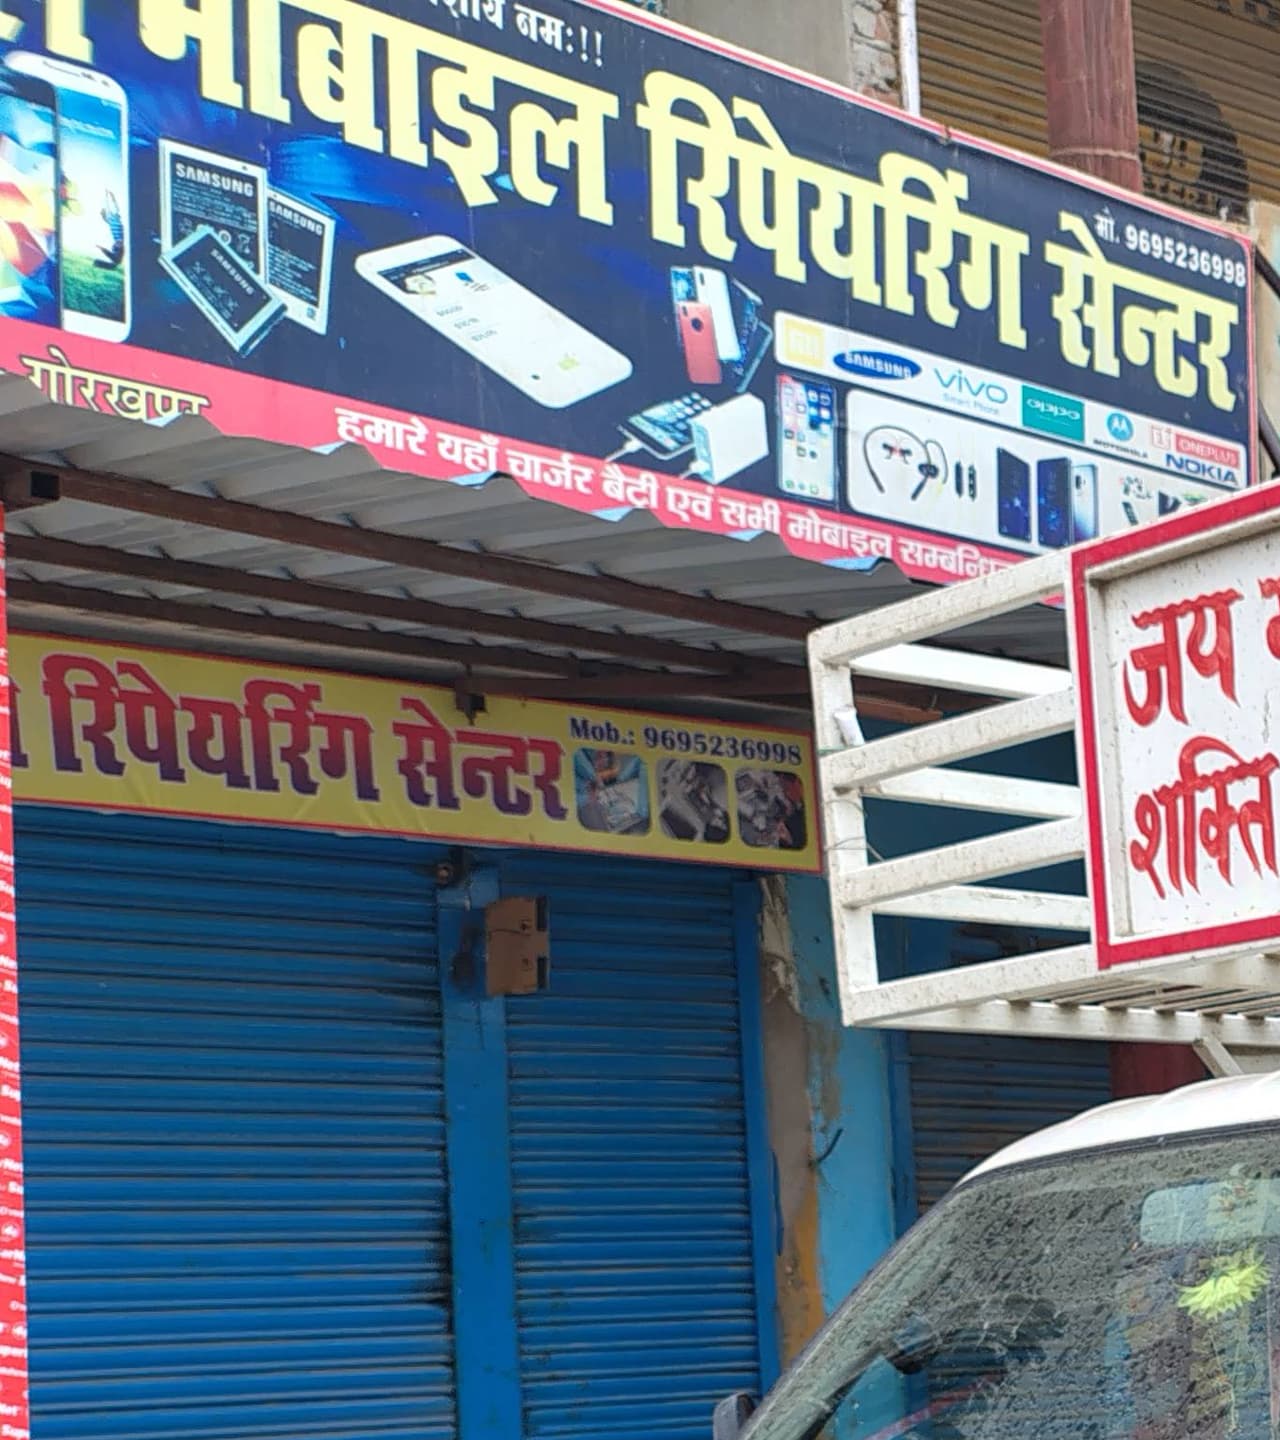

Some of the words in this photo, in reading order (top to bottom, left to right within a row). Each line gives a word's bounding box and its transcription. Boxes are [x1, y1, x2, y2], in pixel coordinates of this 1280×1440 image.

[175, 162, 255, 197] SAMSUNG
[269, 200, 324, 236] SAMSUNG
[210, 248, 255, 295] SAMSUNG
[1125, 223, 1247, 288] 9695236998
[1044, 210, 1239, 412] सेन्टर
[844, 351, 913, 380] SAMSUNG
[335, 407, 429, 456] हमारे
[436, 433, 500, 472] यहाँ
[506, 450, 594, 495] चार्जर
[665, 483, 713, 524] एवं
[719, 496, 781, 533] सभी
[786, 509, 894, 559] मोबाइल
[1165, 453, 1239, 486] NOKIA
[1123, 587, 1243, 727] जय
[391, 697, 568, 821] सेन्टर
[644, 727, 802, 765] 9695236998
[1129, 735, 1280, 900] शक्ति
